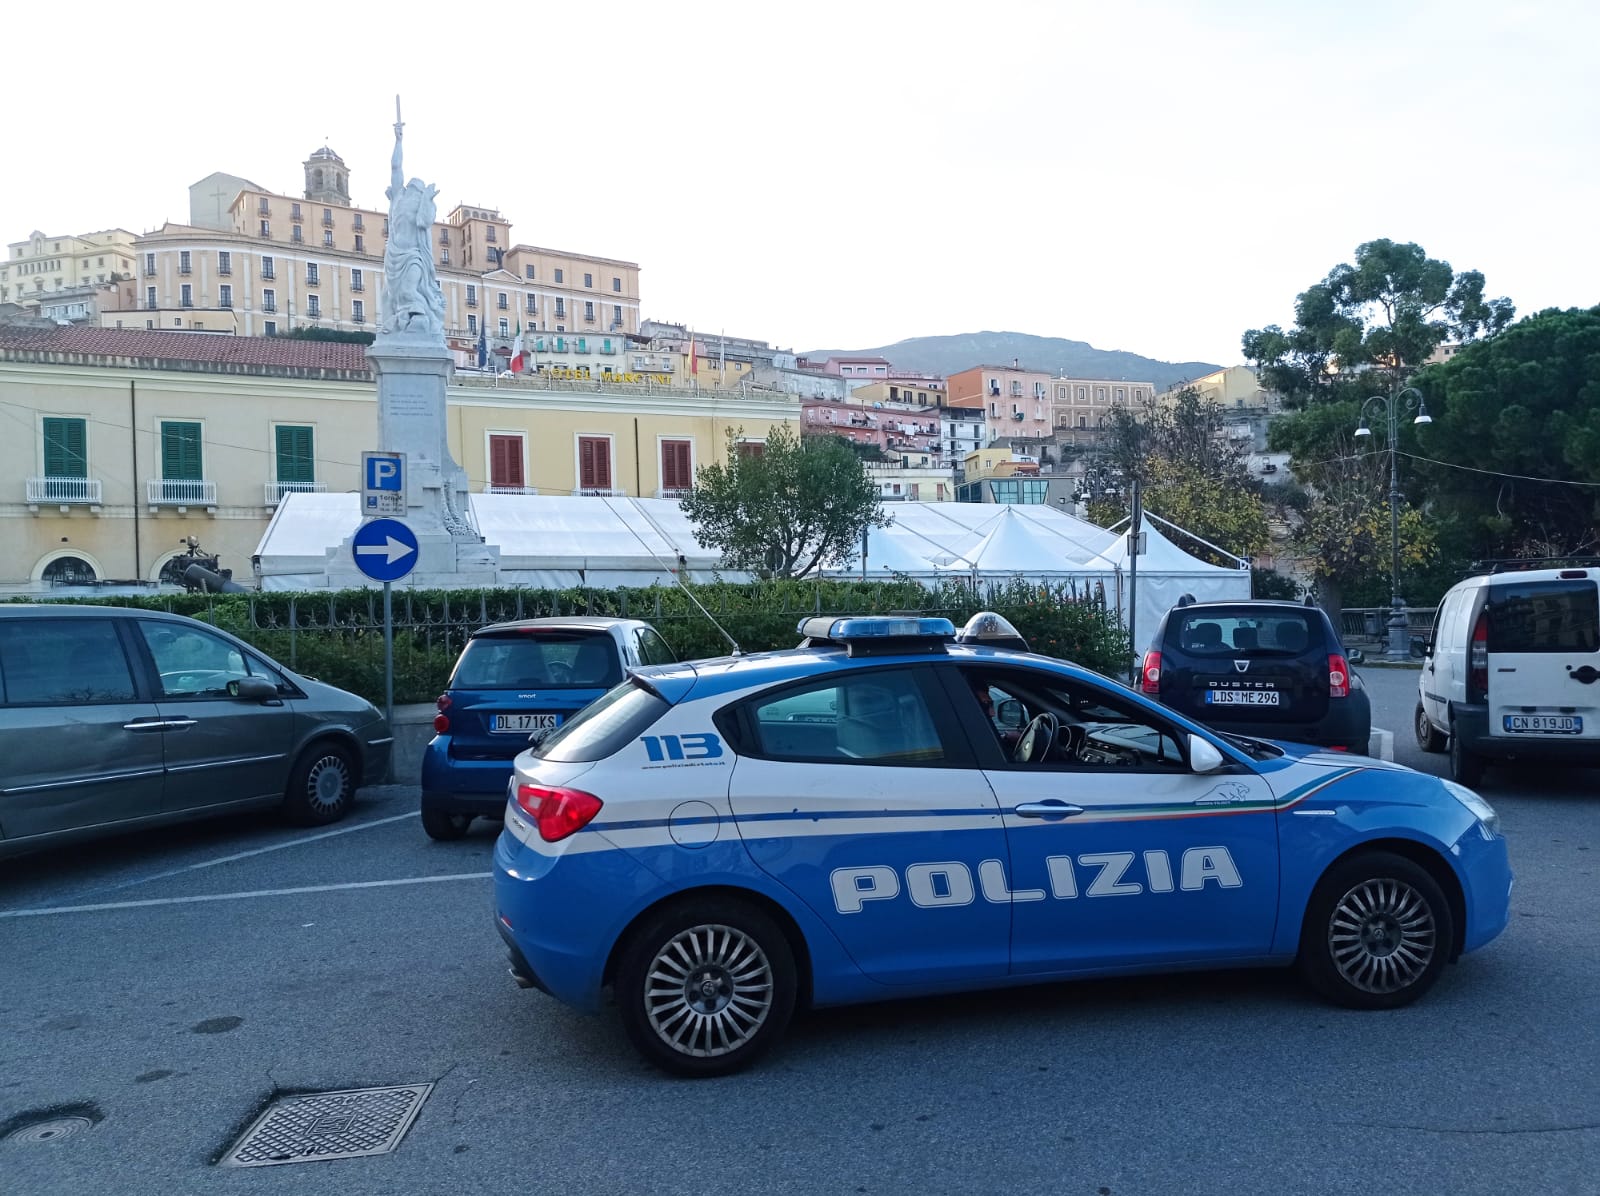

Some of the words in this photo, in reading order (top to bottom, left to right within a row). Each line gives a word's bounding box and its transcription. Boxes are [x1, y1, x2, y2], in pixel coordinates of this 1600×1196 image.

[375, 460, 397, 488] P
[1213, 691, 1234, 703] LDS
[1241, 692, 1256, 703] ME
[1257, 692, 1278, 704] 296
[640, 732, 723, 761] 113
[829, 845, 1244, 914] POLIZIA
